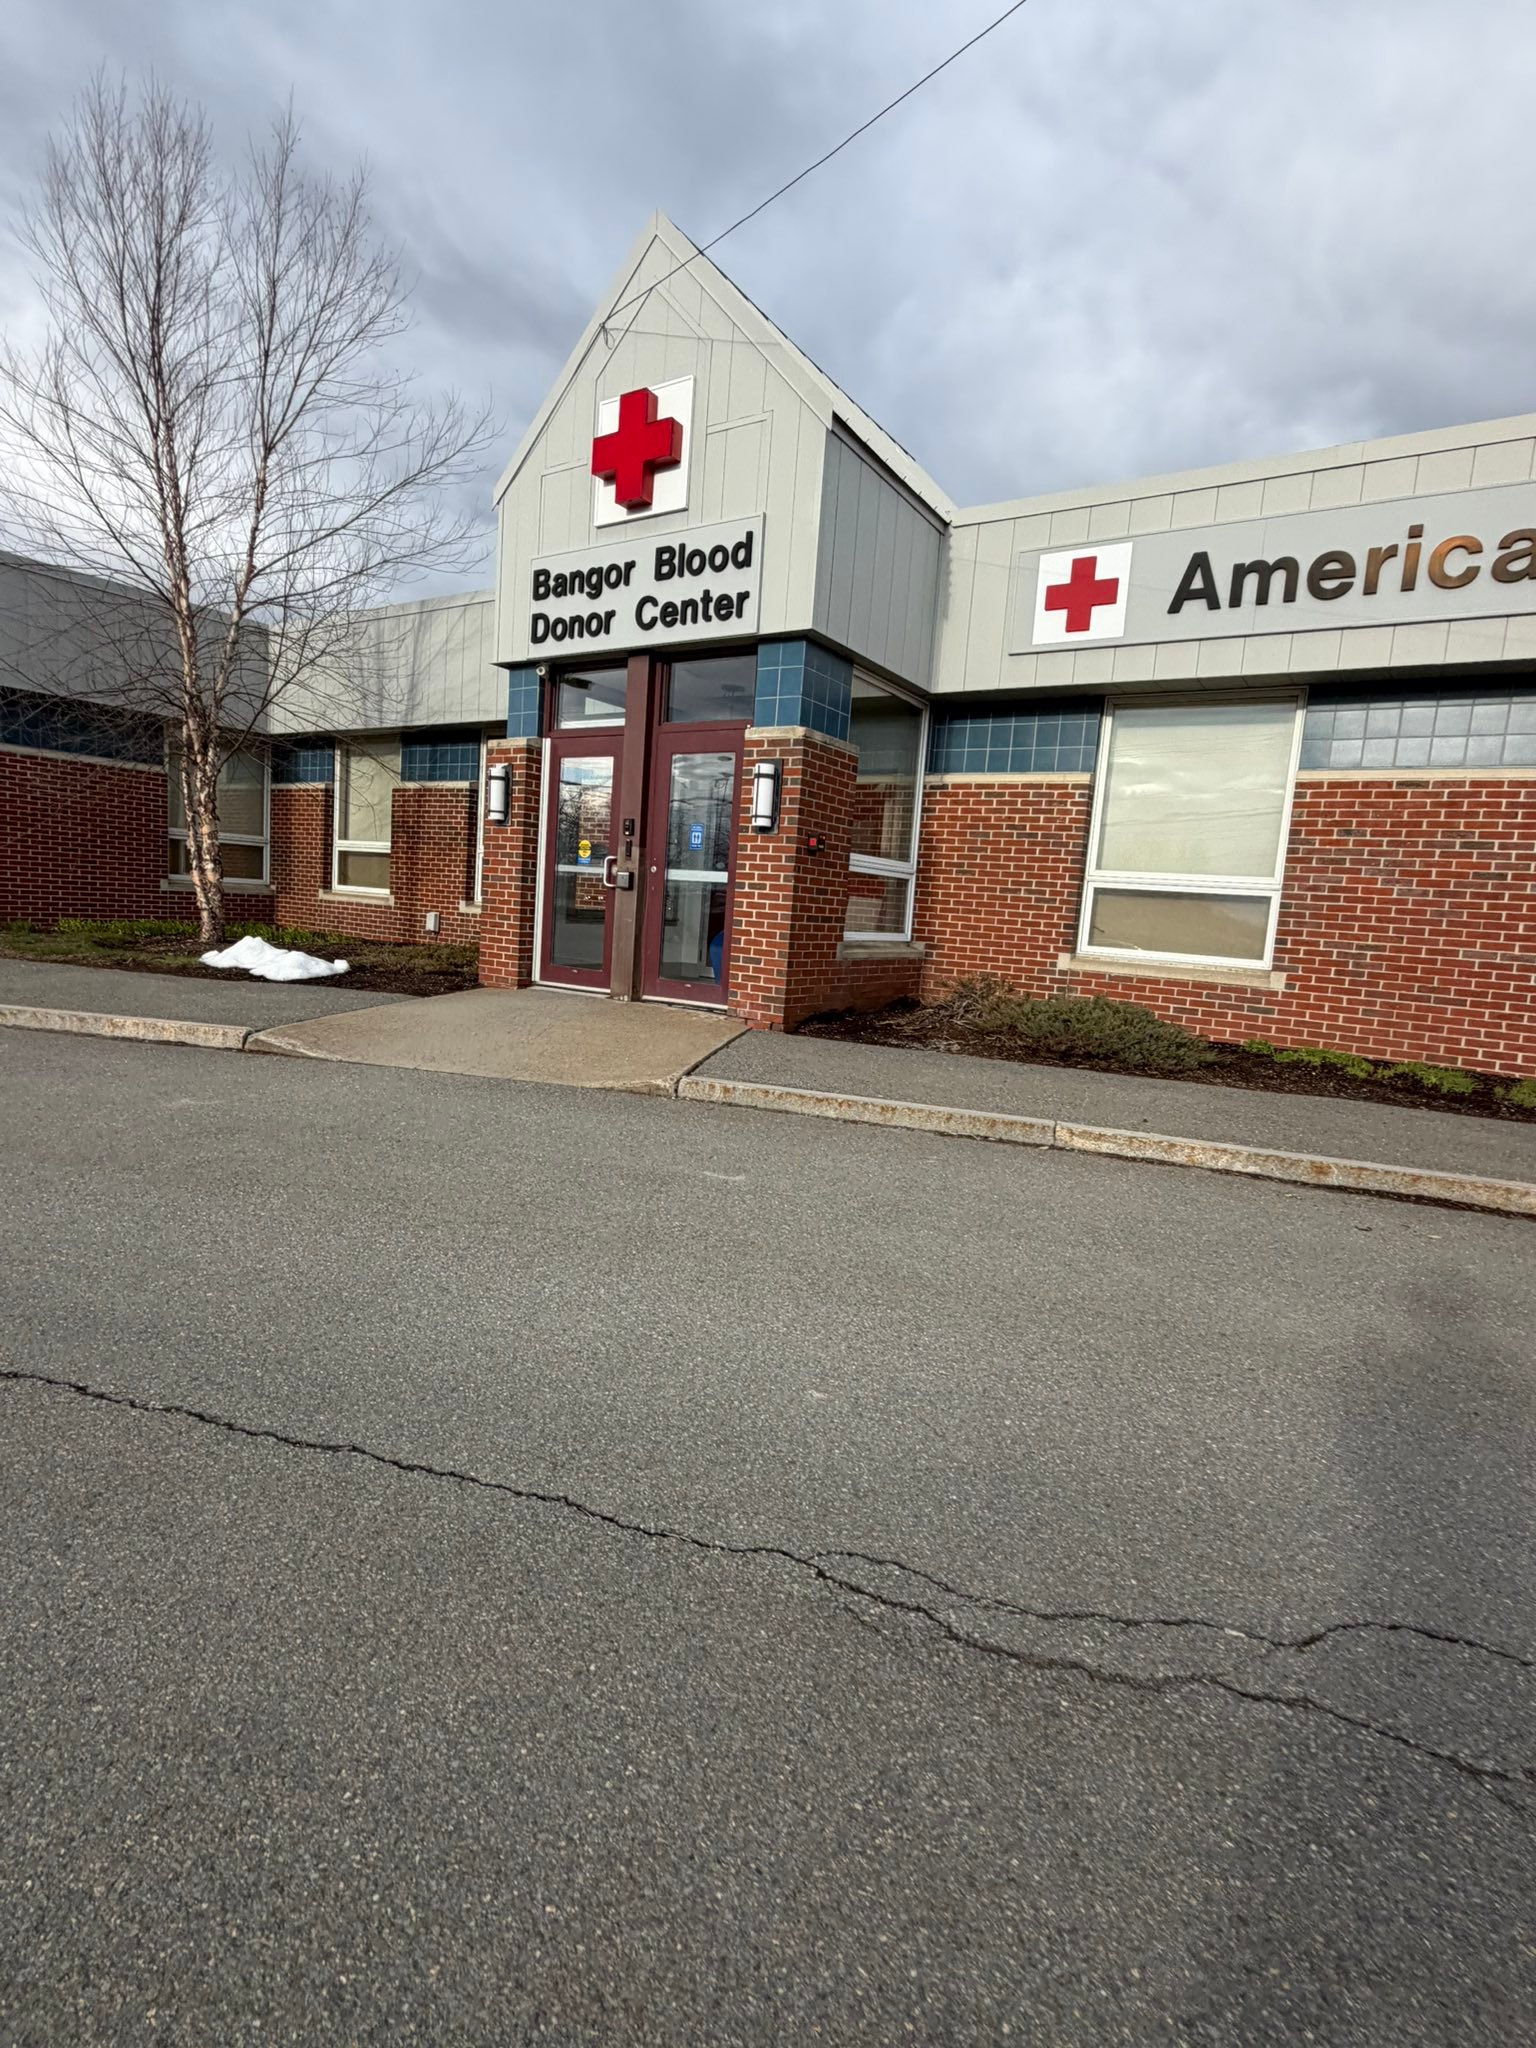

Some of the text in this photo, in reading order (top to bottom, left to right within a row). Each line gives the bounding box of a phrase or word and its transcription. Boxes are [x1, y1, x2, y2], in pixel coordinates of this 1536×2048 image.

[532, 531, 754, 601] Bangor Blood
[531, 589, 750, 644] Donor Center
